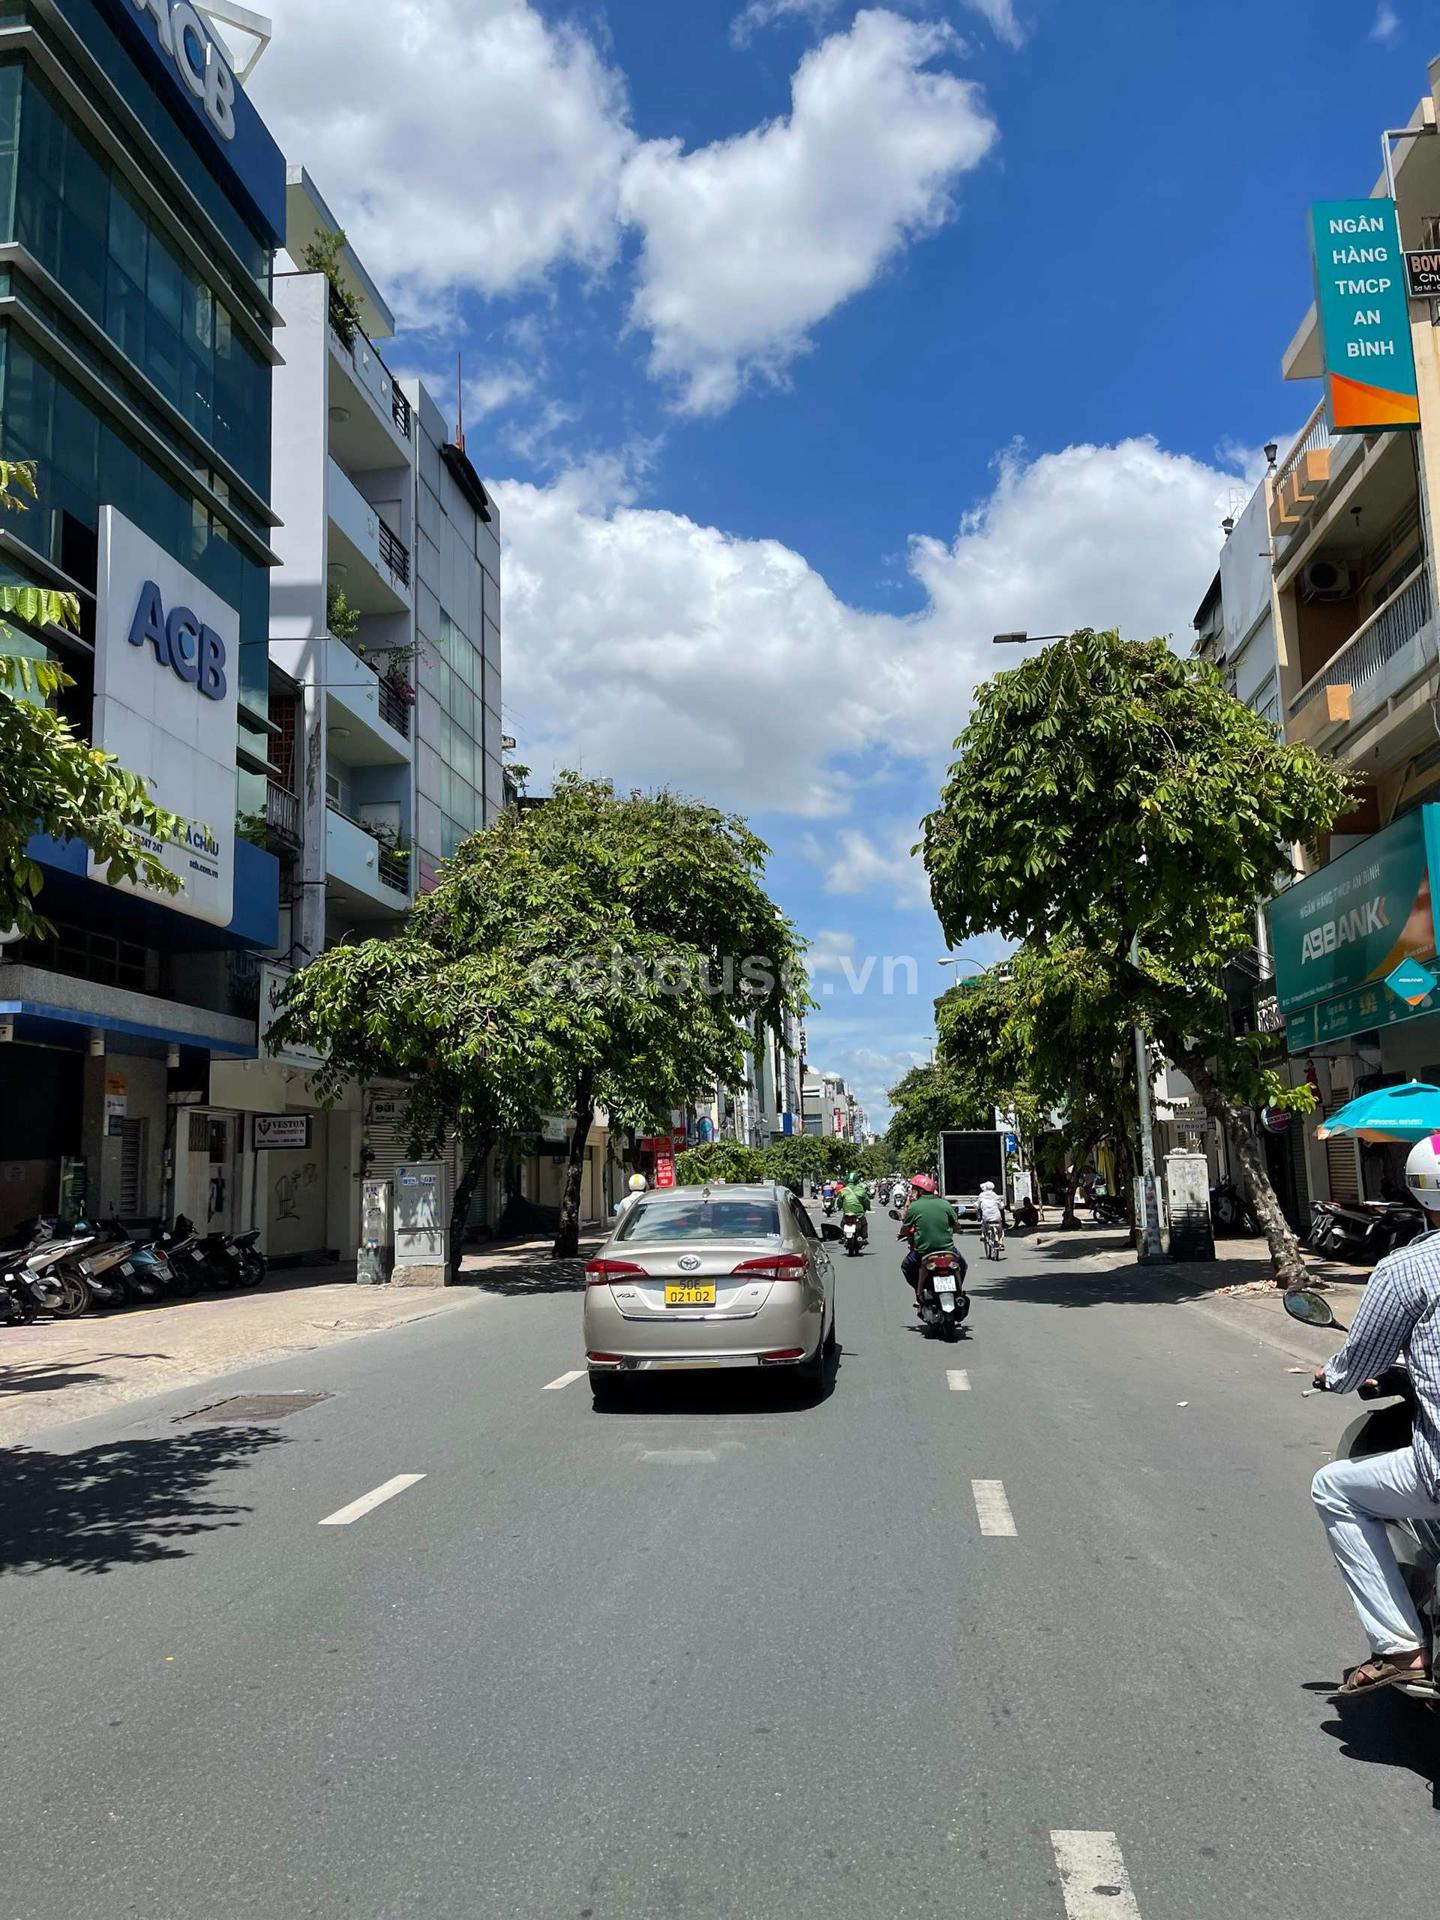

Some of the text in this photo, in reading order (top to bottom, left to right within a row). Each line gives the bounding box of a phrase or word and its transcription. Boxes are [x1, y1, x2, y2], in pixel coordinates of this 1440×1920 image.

[1329, 215, 1384, 234] NGÂN
[1332, 246, 1388, 265] HÀNG
[1411, 255, 1440, 273] BOV
[1335, 278, 1391, 295] TMCP
[1353, 310, 1381, 326] AN
[1346, 339, 1395, 358] BÌNH
[128, 580, 227, 701] ACB
[193, 832, 219, 857] CHU
[270, 1120, 305, 1129] VESTON
[679, 1279, 701, 1291] 50E
[670, 1291, 710, 1303] 021.02
